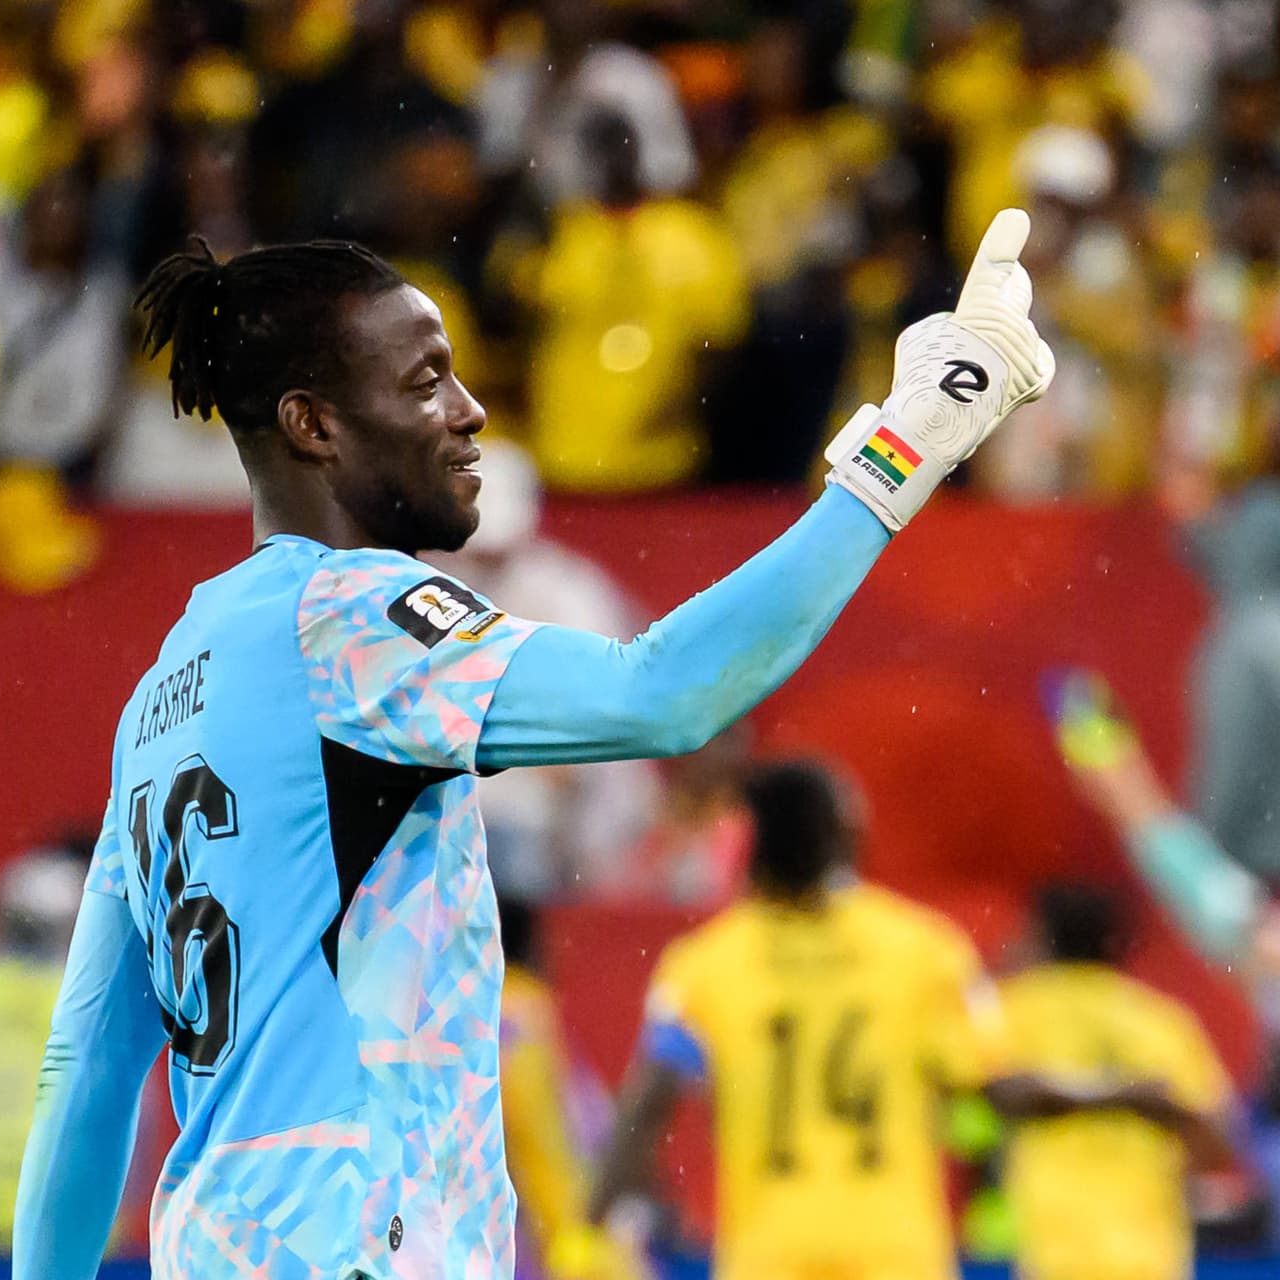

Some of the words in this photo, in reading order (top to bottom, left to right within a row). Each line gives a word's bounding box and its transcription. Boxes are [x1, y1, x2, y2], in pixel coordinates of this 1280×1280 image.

[851, 455, 899, 494] B.ASARE
[128, 752, 239, 1077] 16
[764, 1004, 883, 1176] 14
